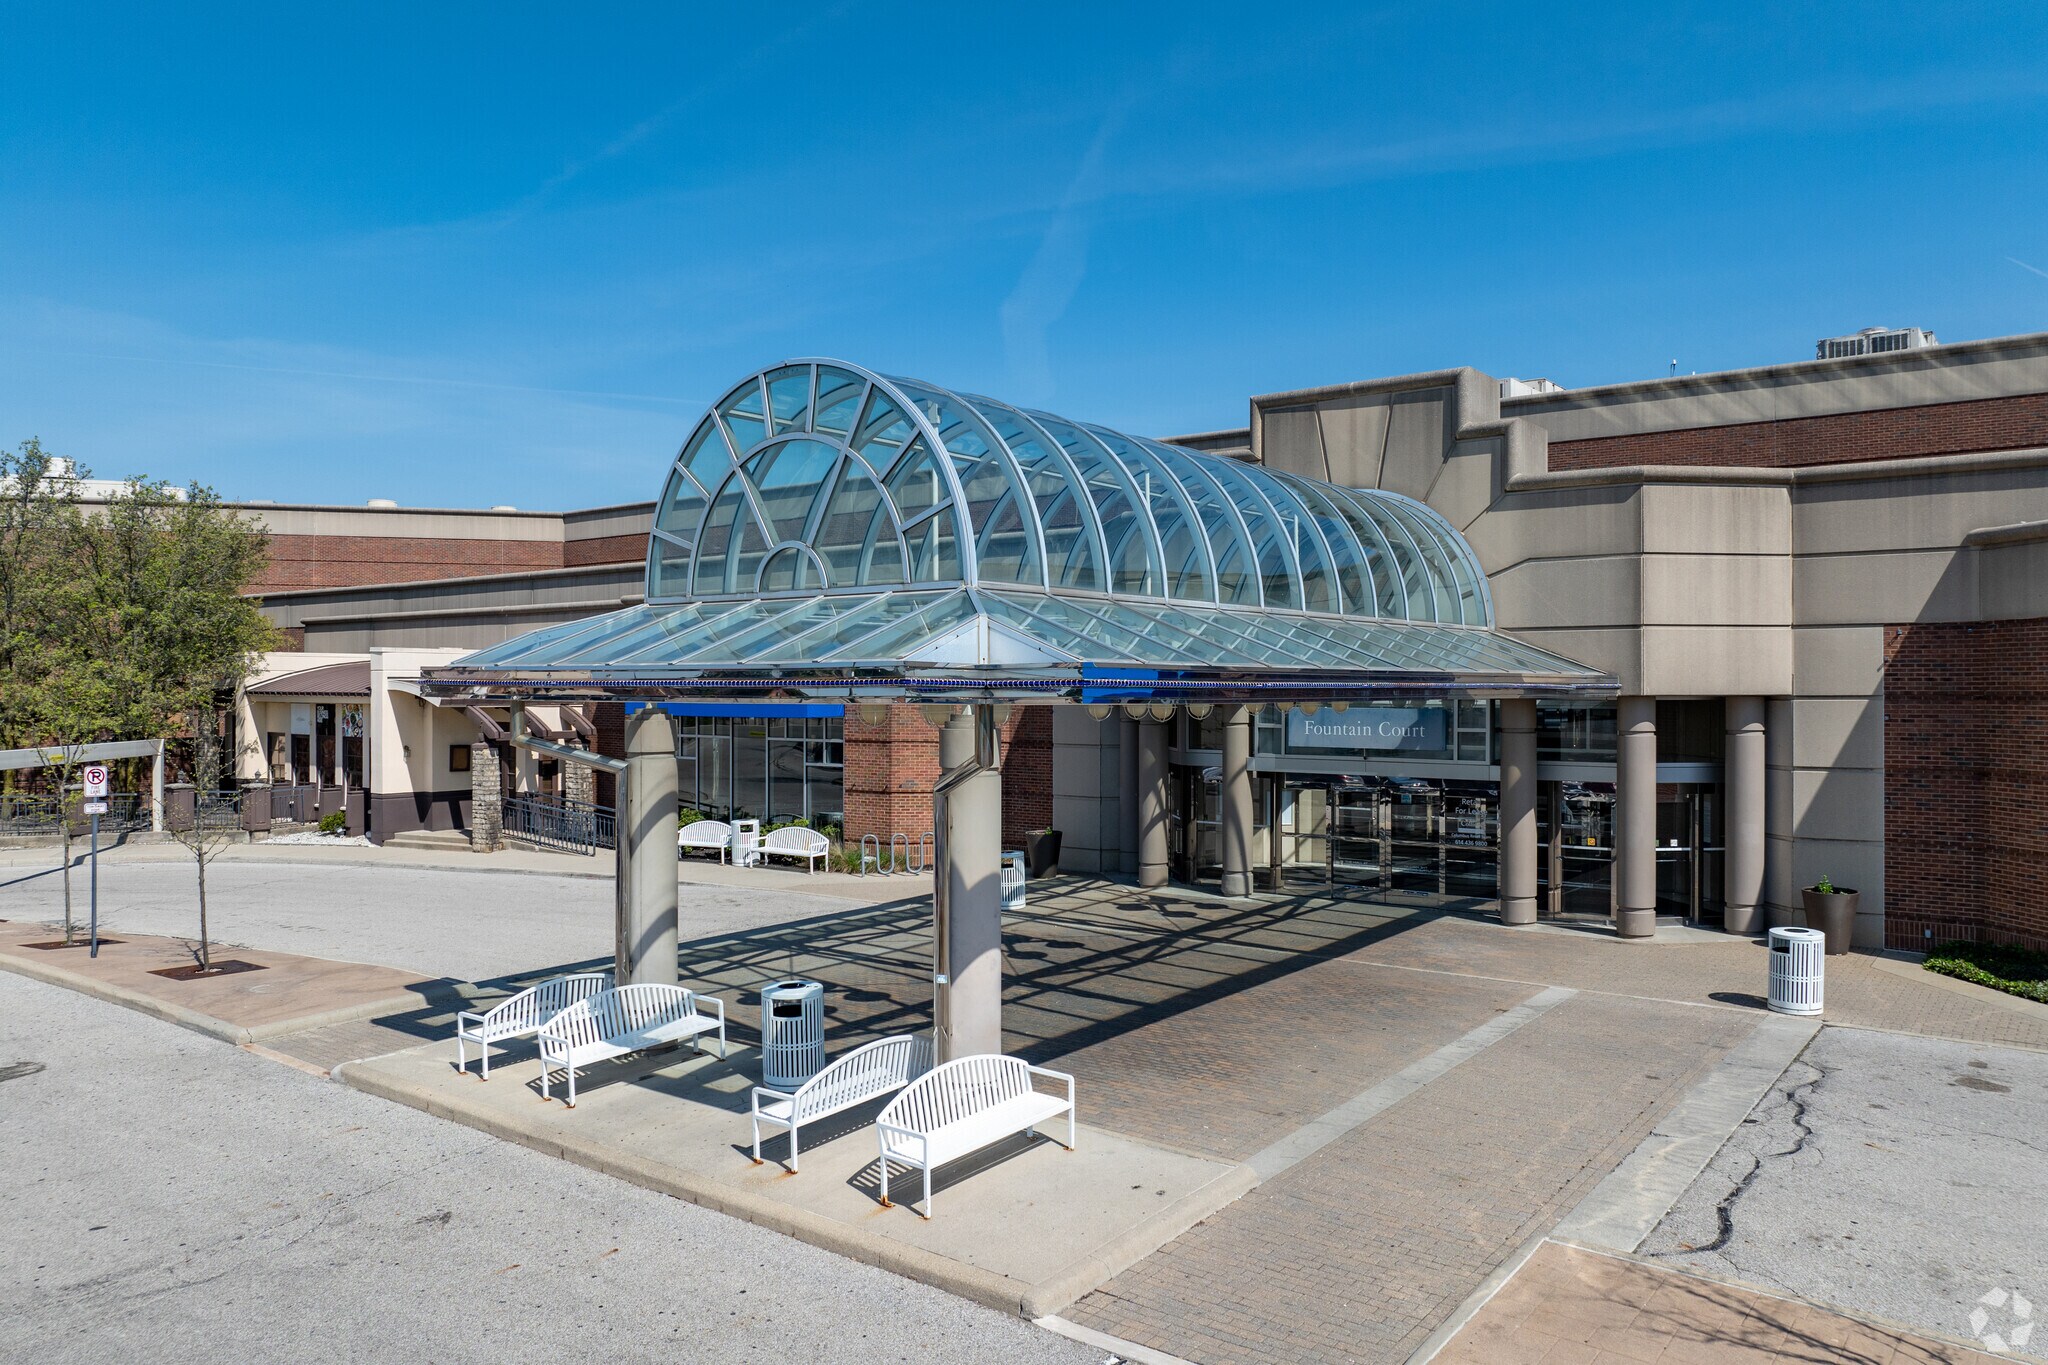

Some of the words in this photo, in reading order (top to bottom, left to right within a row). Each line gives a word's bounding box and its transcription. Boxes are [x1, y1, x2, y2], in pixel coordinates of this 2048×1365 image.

[1305, 720, 1371, 736] Fountain
[1378, 721, 1425, 738] Court
[1455, 807, 1467, 815] For
[1468, 807, 1488, 816] Lease
